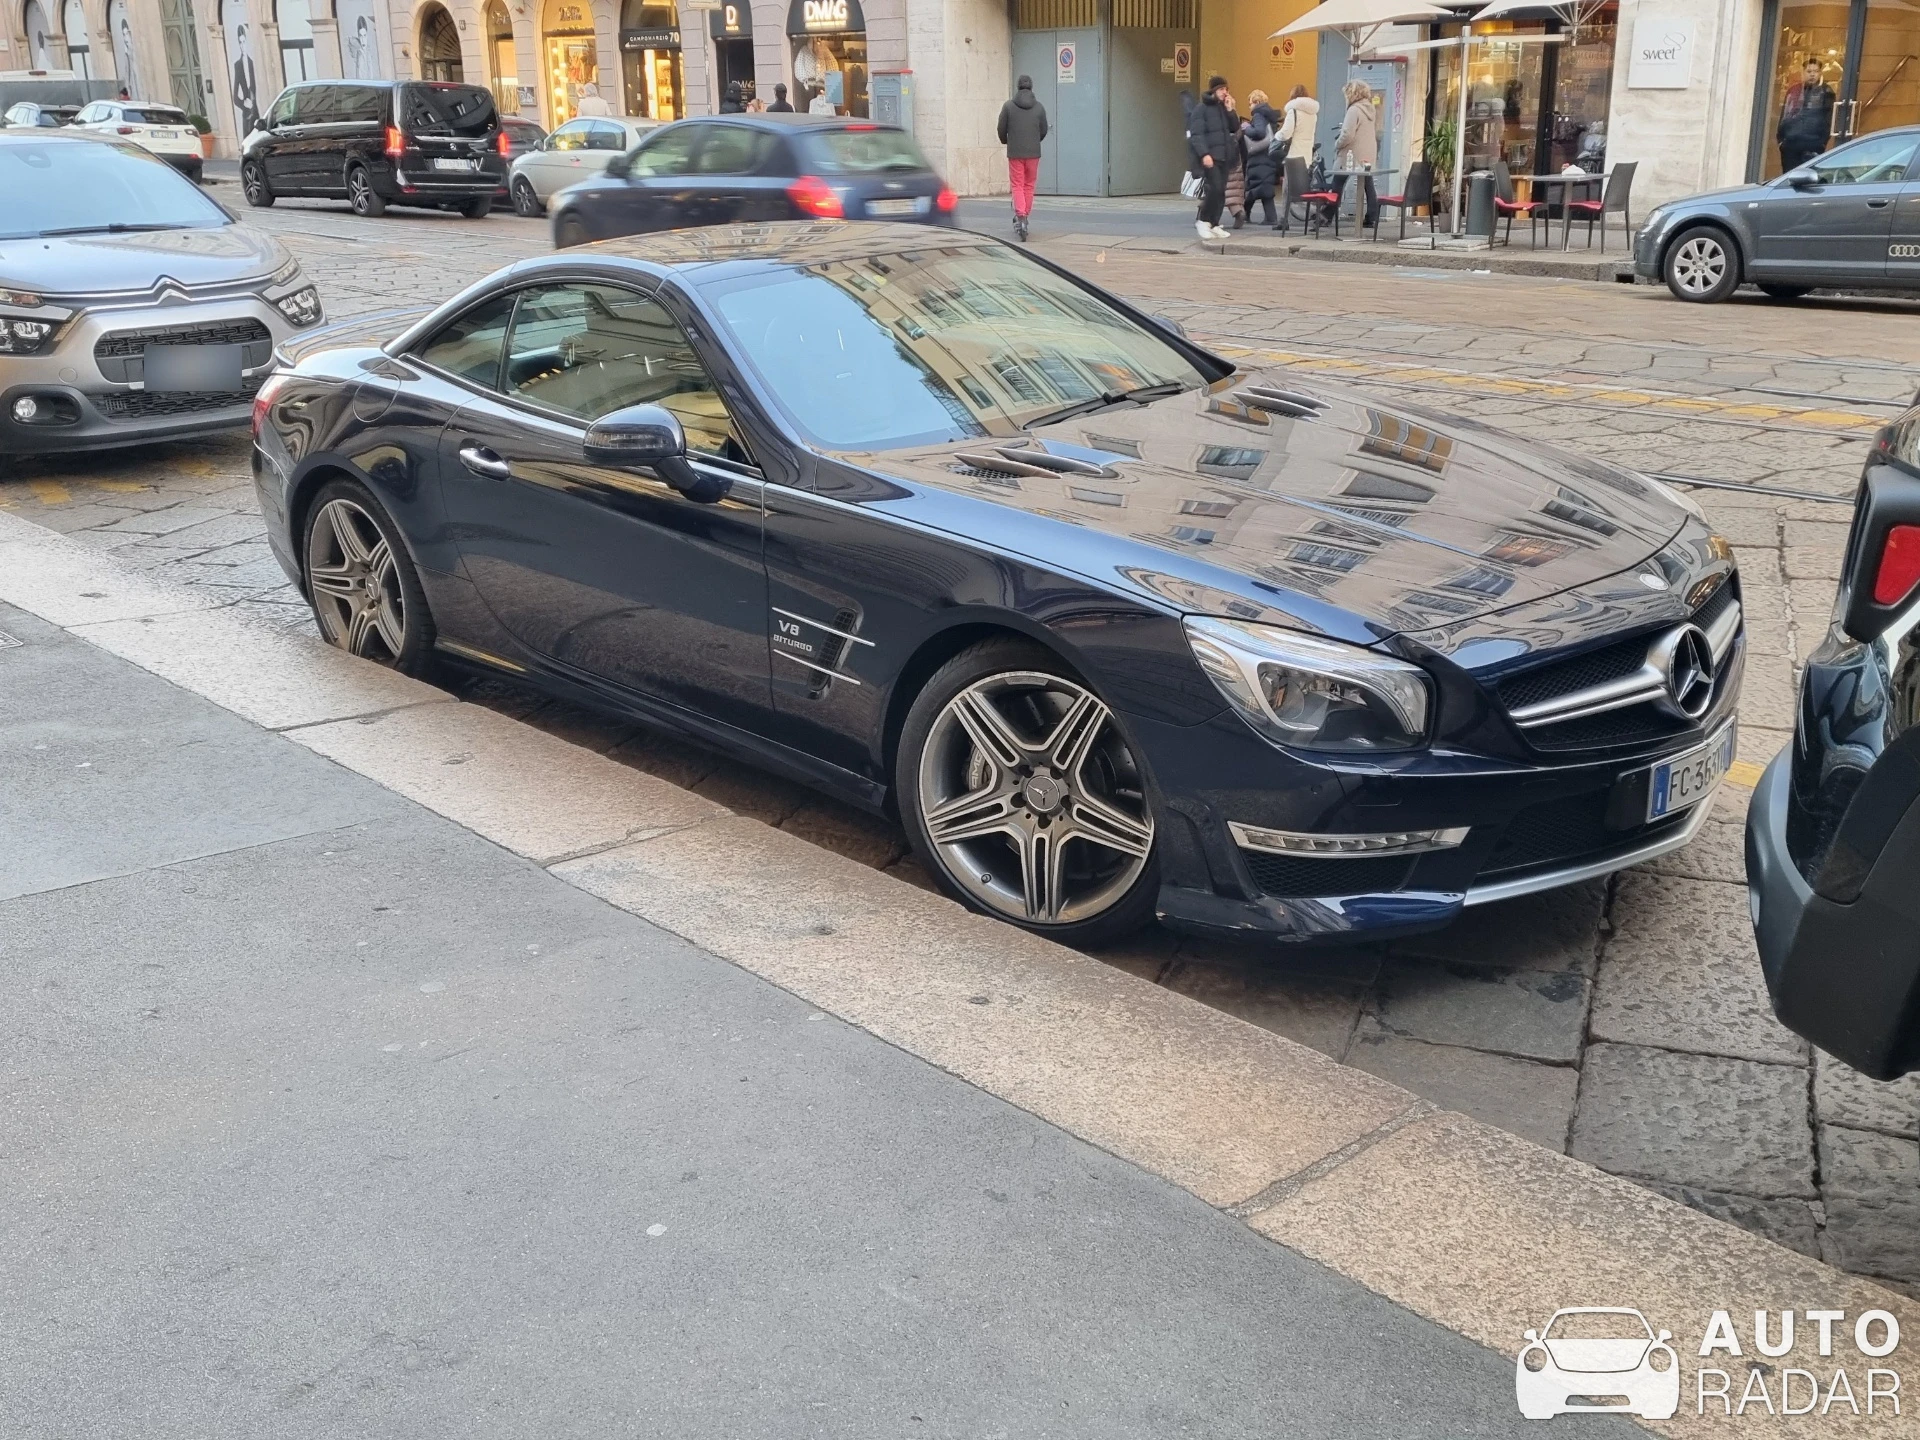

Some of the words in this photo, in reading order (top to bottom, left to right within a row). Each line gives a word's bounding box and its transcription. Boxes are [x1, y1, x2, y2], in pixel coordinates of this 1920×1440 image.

[726, 5, 737, 25] D
[669, 31, 680, 43] 70
[1642, 47, 1676, 60] sweet
[778, 619, 800, 635] V8
[773, 633, 813, 652] BITURBO
[1669, 766, 1690, 802] FC
